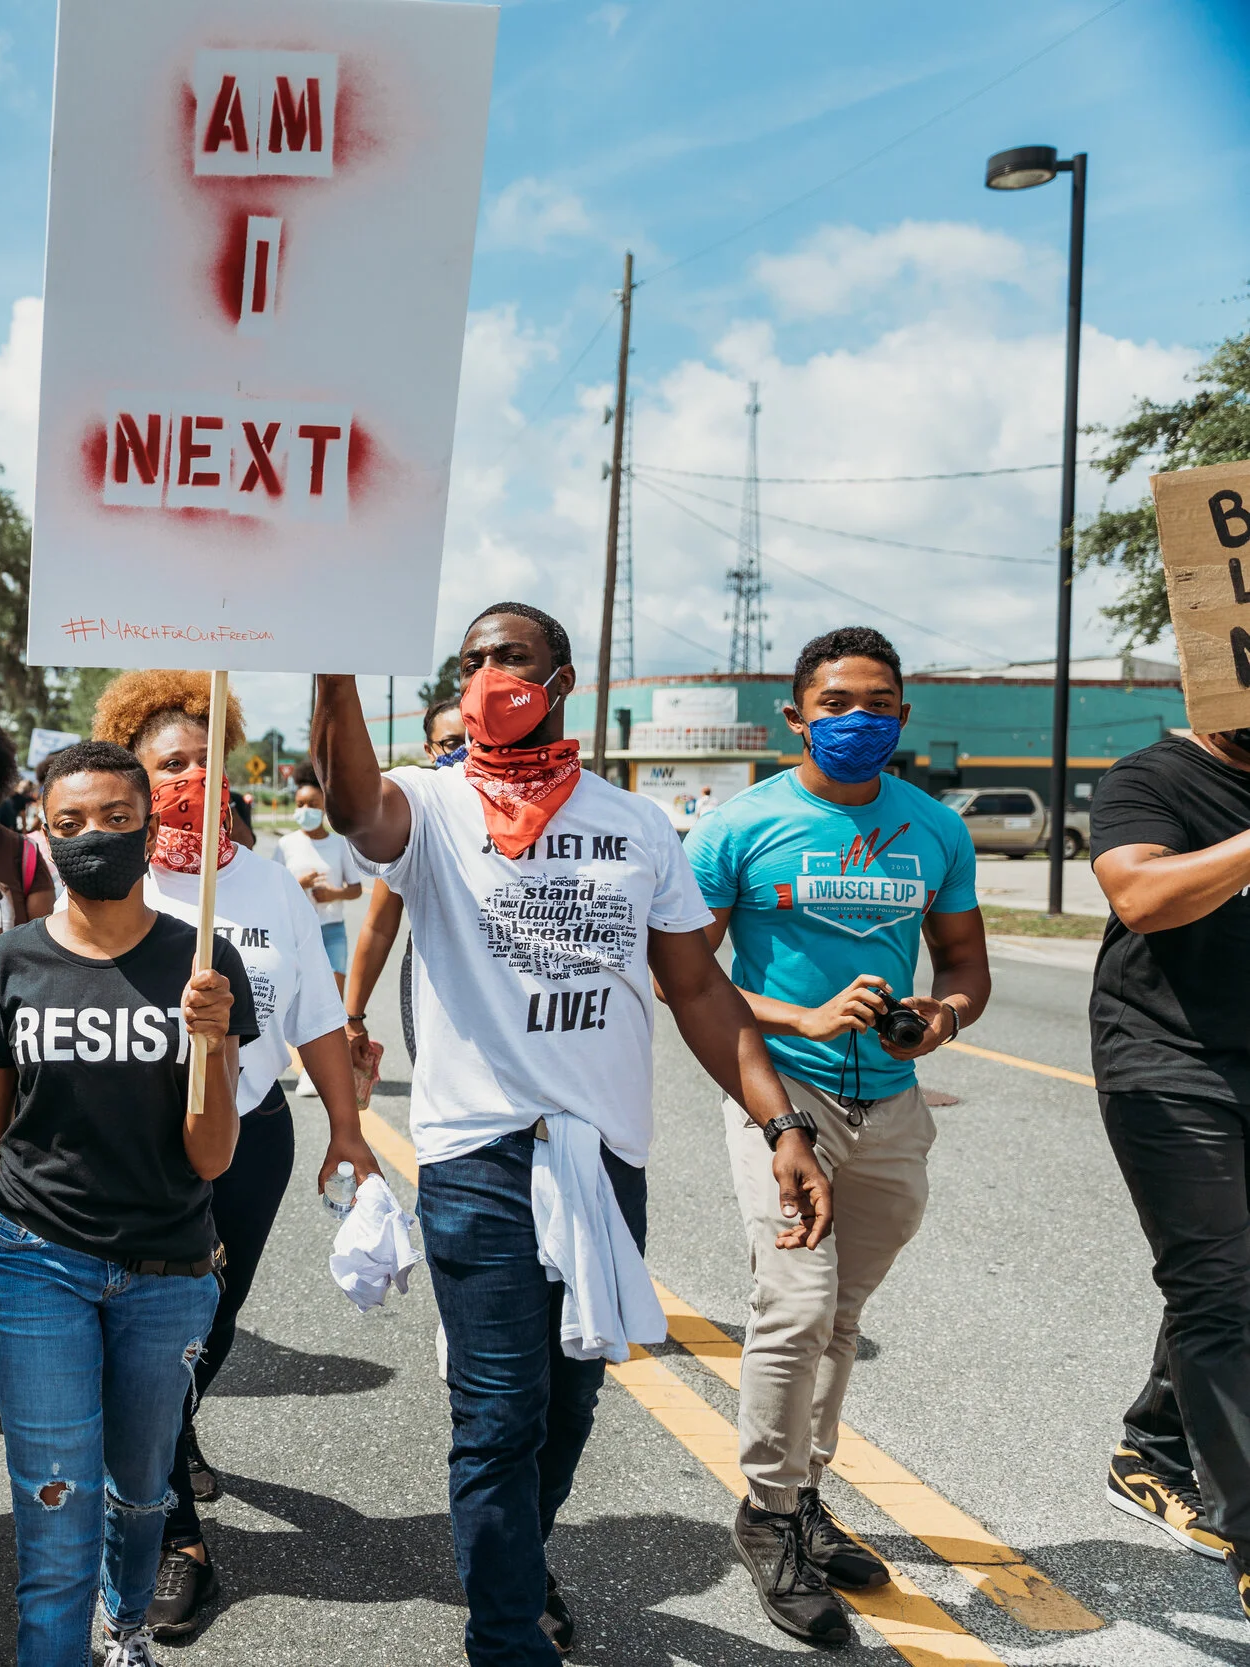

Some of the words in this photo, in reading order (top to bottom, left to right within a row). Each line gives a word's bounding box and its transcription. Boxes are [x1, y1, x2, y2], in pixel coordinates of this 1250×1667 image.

[202, 75, 323, 154] AM
[251, 240, 270, 314] I
[112, 413, 342, 498] NEXT
[546, 834, 583, 860] LET
[592, 836, 628, 861] ME
[523, 883, 595, 900] stand
[597, 894, 627, 902] socialize
[809, 880, 917, 903] iMUSCLEUP
[500, 900, 519, 908] WALK
[519, 900, 582, 926] laugh
[585, 910, 607, 919] shop
[609, 911, 626, 920] play
[512, 921, 615, 943] breathe
[596, 922, 625, 930] socialize
[240, 928, 270, 948] ME
[515, 942, 531, 950] VOTE
[509, 960, 531, 968] laugh
[573, 966, 600, 976] SOCIALIZE
[552, 972, 571, 980] SPEAK
[526, 987, 611, 1033] LIVE!
[16, 1006, 190, 1065] RESIST
